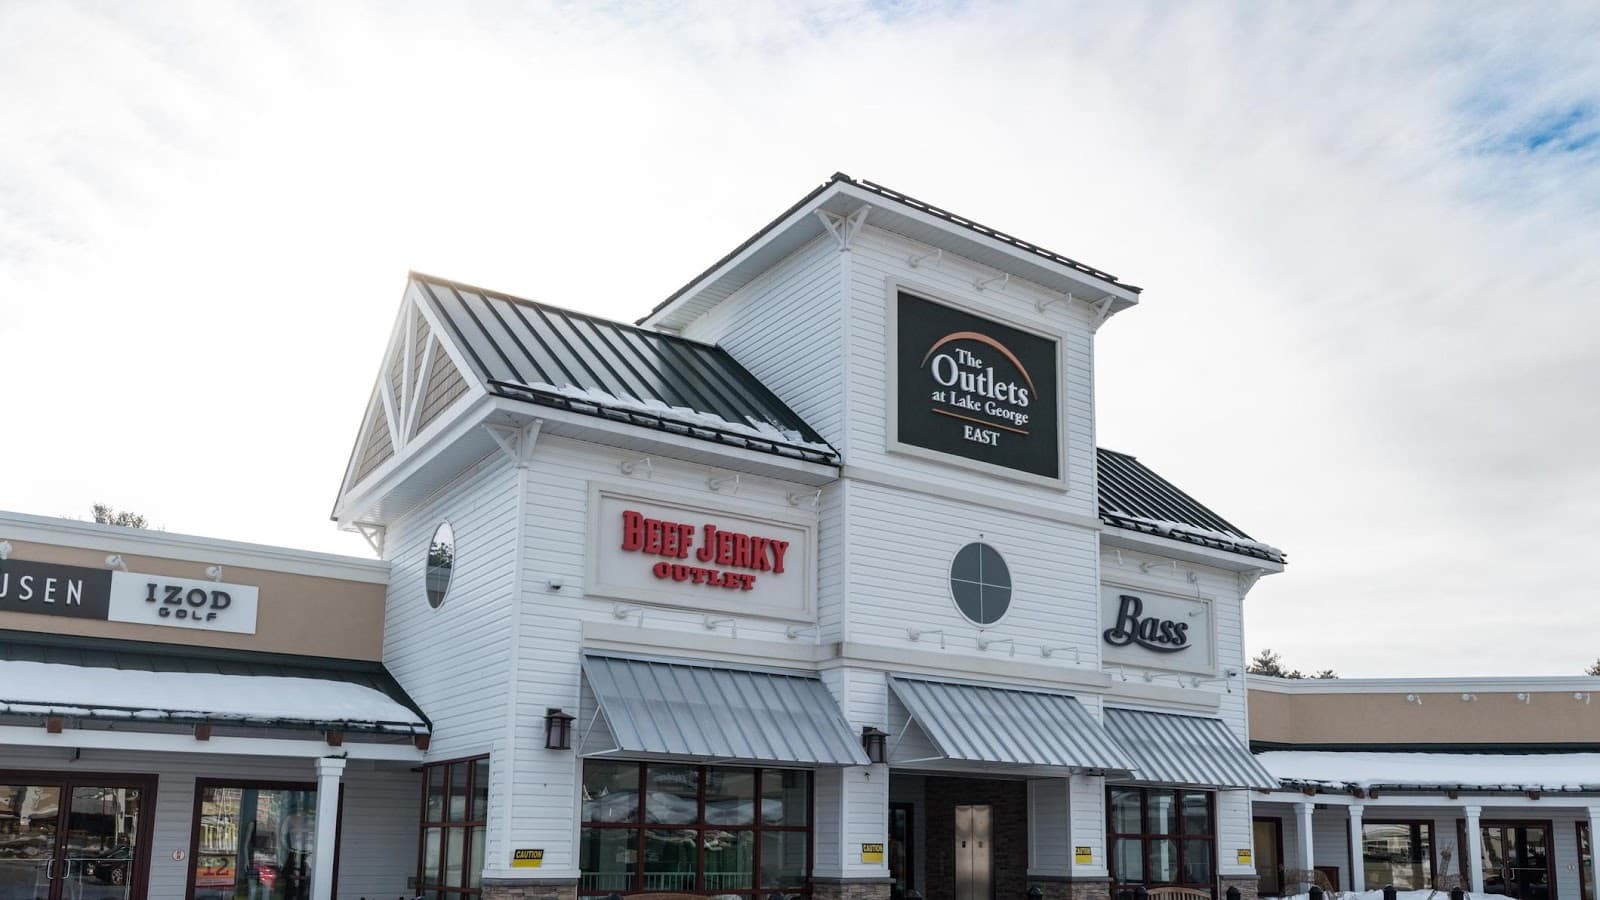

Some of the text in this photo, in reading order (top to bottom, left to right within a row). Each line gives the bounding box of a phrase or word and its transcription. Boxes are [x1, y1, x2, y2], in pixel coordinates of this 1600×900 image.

[955, 348, 983, 368] The
[931, 353, 1029, 407] Outlets
[931, 391, 1029, 426] at Lake George
[963, 424, 1000, 446] EAST
[622, 510, 789, 574] BEEF JERKY
[653, 562, 756, 590] OUTLET
[145, 583, 232, 610] IZOD
[158, 607, 217, 622] GOLF
[1103, 594, 1192, 654] Bass
[514, 850, 543, 859] CAUTION
